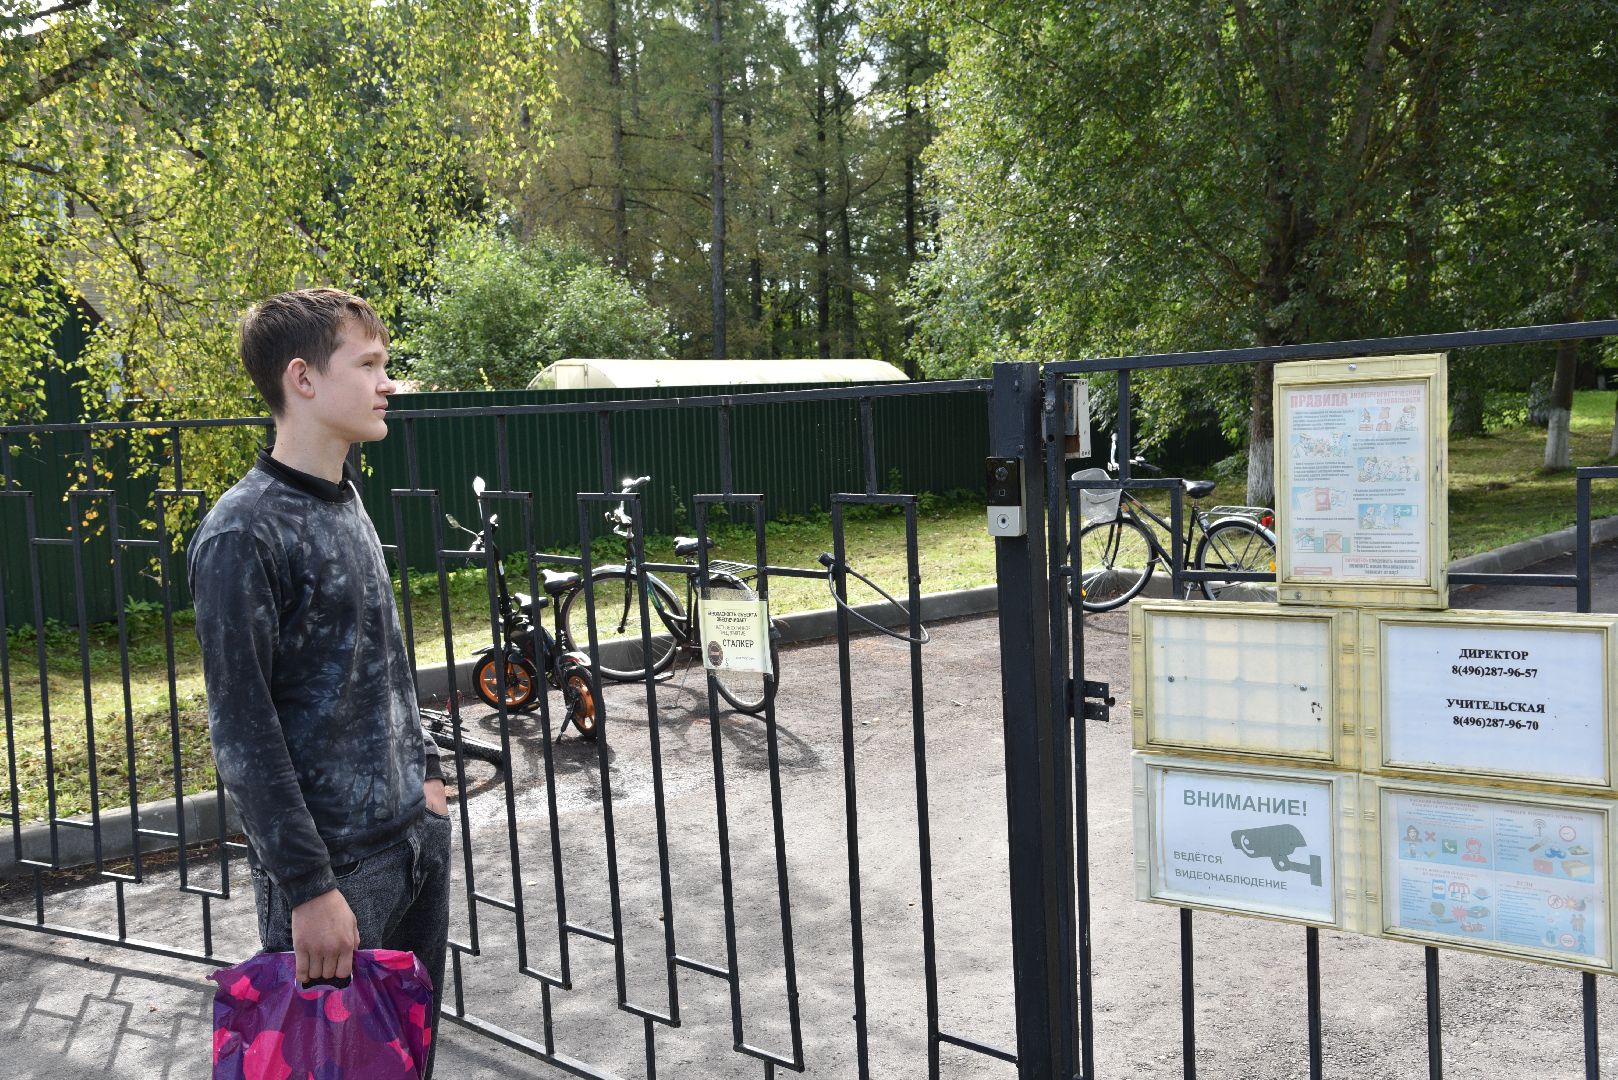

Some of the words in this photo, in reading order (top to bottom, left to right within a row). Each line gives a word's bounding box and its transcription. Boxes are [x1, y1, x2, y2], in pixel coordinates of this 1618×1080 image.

[1290, 393, 1348, 408] ПРАВИЛА
[722, 638, 755, 648] СТАЛКЕР
[1459, 649, 1529, 661] ДИРЕКТОР
[1451, 665, 1538, 678] 8(496)287-96-57
[1446, 698, 1546, 713] УЧИТЕЛЬСКАЯ
[1453, 716, 1539, 730] 8(496)287-96-70
[1183, 789, 1307, 816] ВНИМАНИЕ!
[1173, 850, 1223, 864] ВЕДЁТСЯ
[1175, 868, 1288, 890] ВИДЕОНАБЛЮДЕНИЕ
